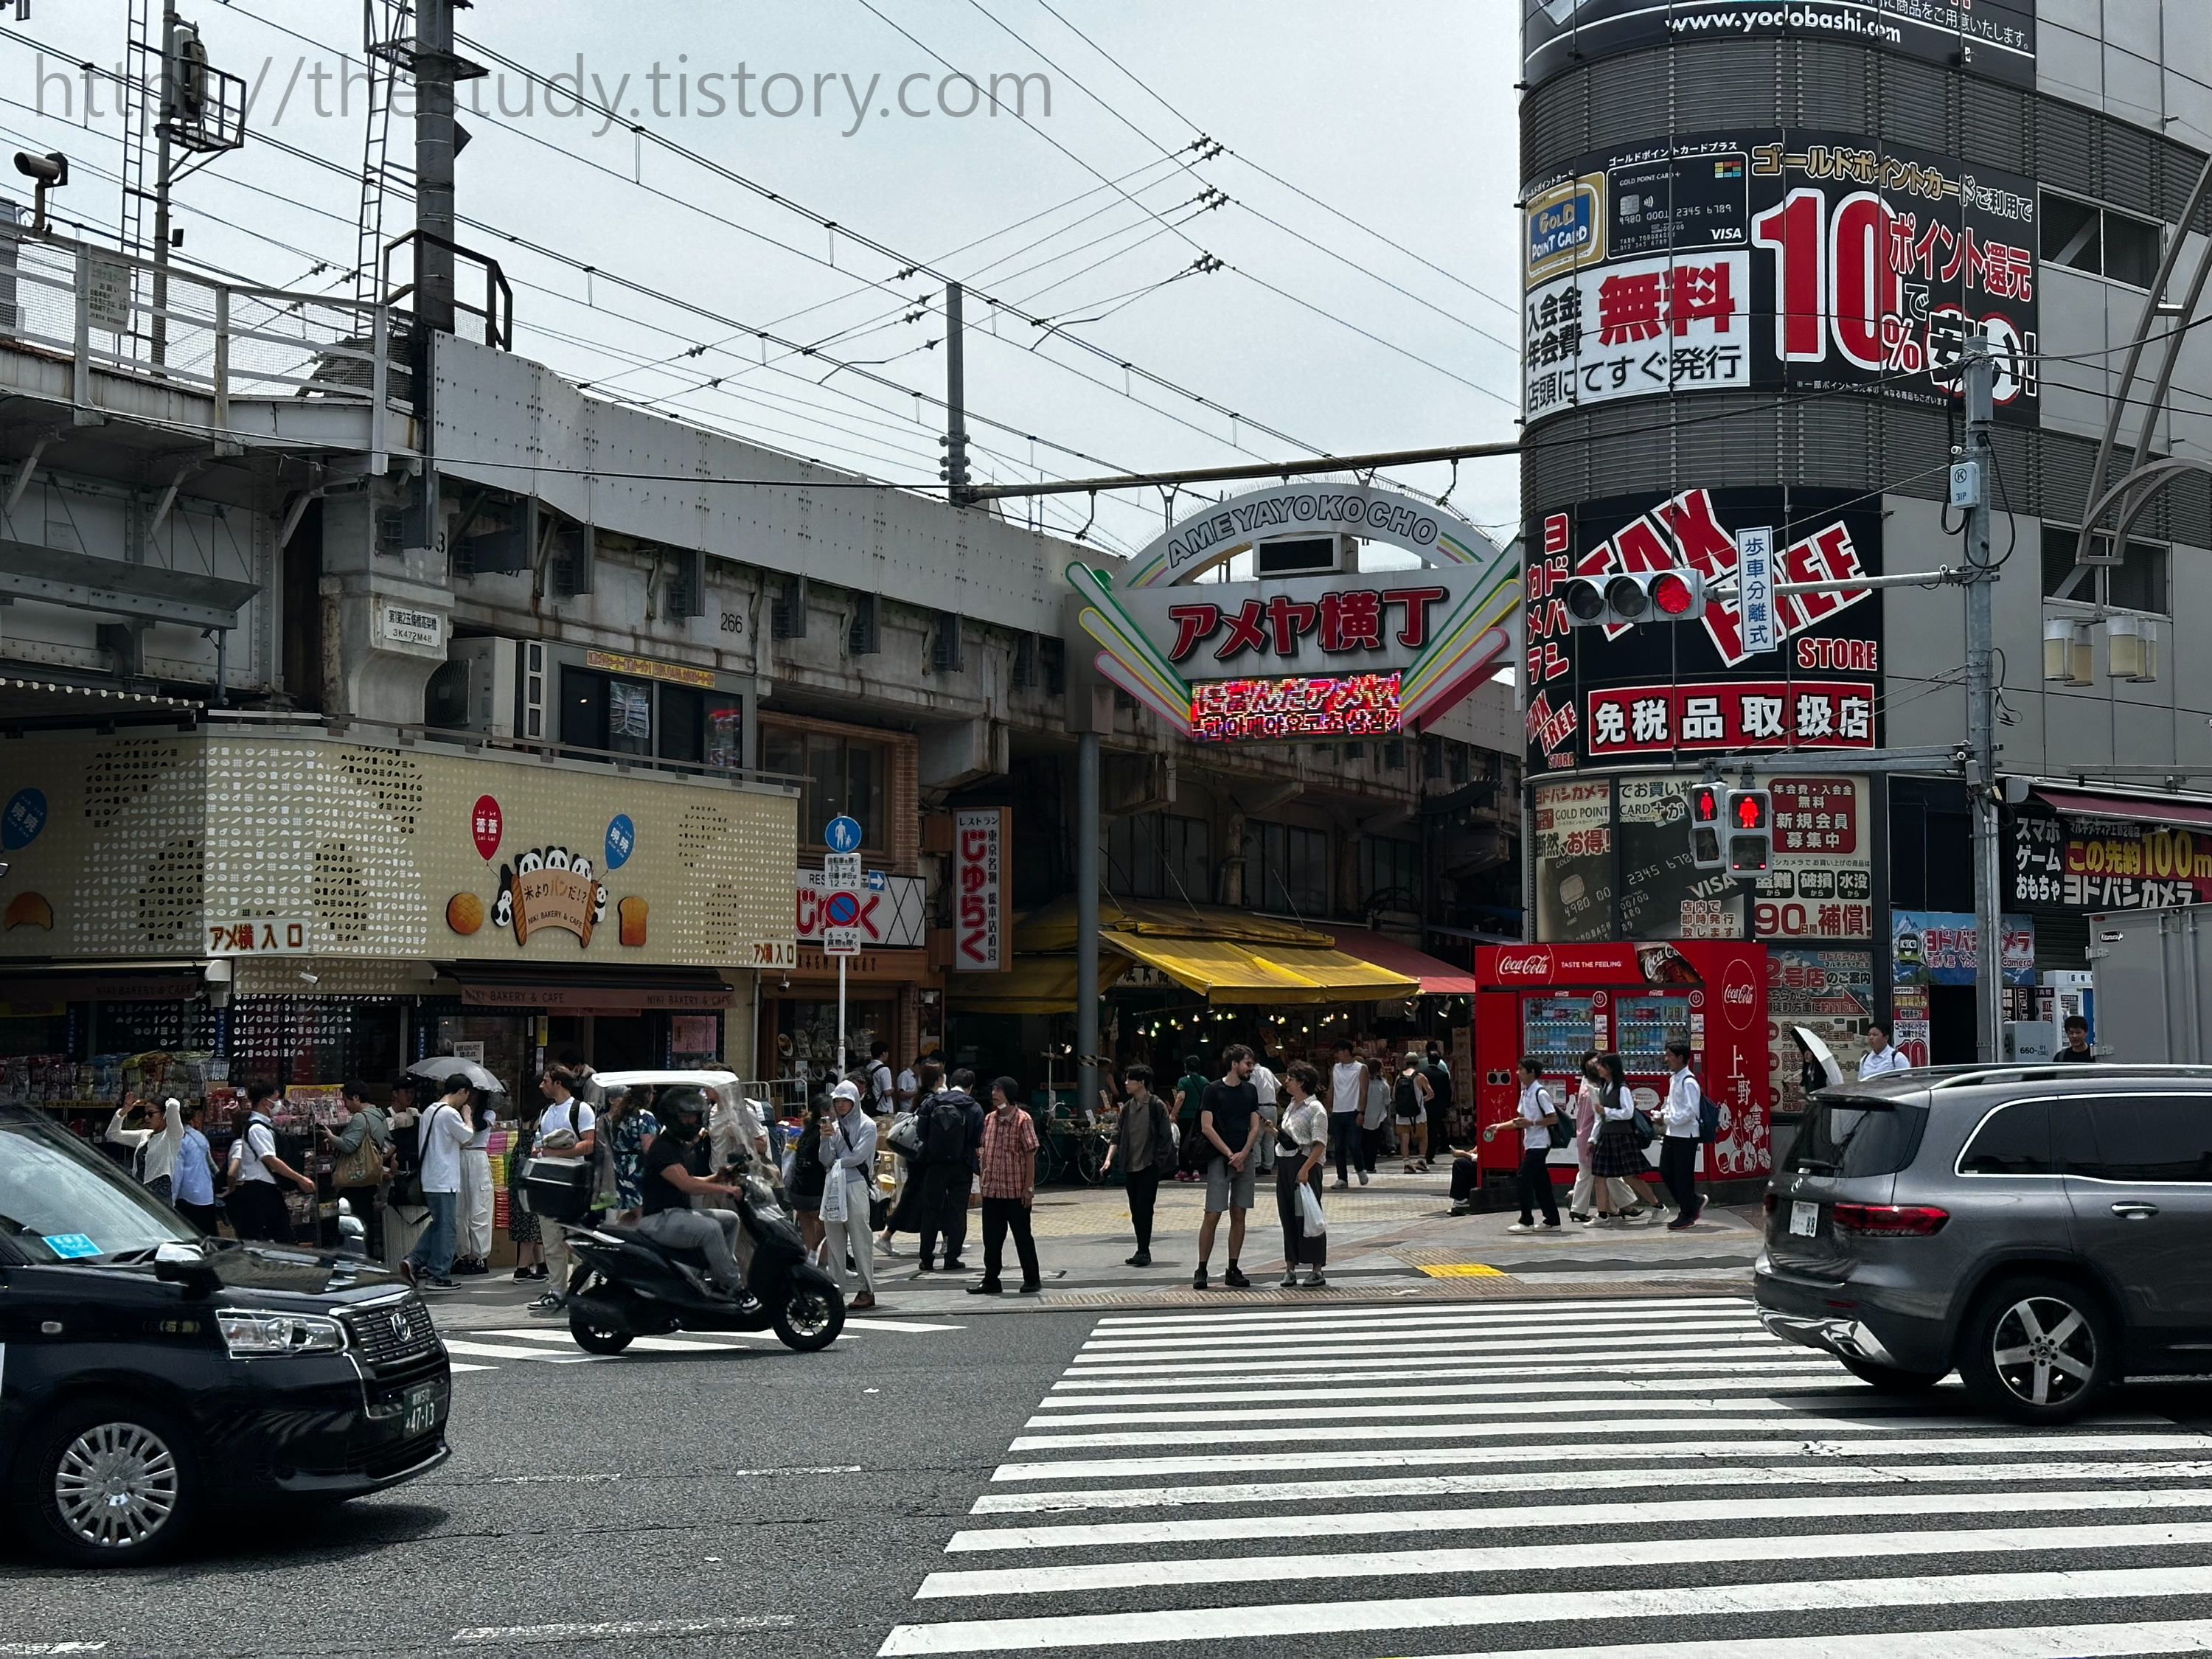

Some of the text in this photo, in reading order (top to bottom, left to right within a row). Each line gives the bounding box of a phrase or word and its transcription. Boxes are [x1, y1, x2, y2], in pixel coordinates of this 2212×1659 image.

[1665, 9, 1901, 44] www.yodobashi.com
[1636, 173, 1656, 184] POINT
[1538, 203, 1575, 235] GOLD
[1676, 206, 1701, 218] 2345
[1708, 227, 1743, 240] VISA
[1531, 234, 1556, 261] POINT
[1888, 211, 2032, 303] ポイント還元
[1528, 285, 1583, 338] 入会金
[1598, 262, 1736, 347] 無料
[1527, 322, 1582, 372] 年会費
[1527, 345, 1742, 411] 店頭にてすぐ発行
[1166, 493, 1440, 570] AMEYAYOKOCHO
[1543, 512, 1570, 681] ヨドバシ
[1744, 536, 1770, 646] 歩車分離式
[720, 611, 742, 634] 266
[1166, 585, 1450, 663] アメヤ横丁
[1526, 563, 1543, 686] カメラ
[1796, 636, 1878, 672] STORE
[1526, 689, 1554, 745] TAX
[1540, 700, 1577, 757] FREE
[1593, 694, 1870, 746] 免税品取扱店
[1548, 752, 1575, 769] STORE
[1773, 785, 1852, 796] 年会費・入会金
[1798, 796, 1825, 809] 無料
[959, 816, 998, 827] レストラン
[1556, 809, 1577, 820] GOLD
[1579, 806, 1609, 818] POINT
[1619, 804, 1650, 815] CARD
[1775, 813, 1848, 830] 新規会員
[1787, 832, 1840, 849] 募集中
[2016, 818, 2061, 843] スマホ
[2016, 844, 2062, 872] ゲーム
[1627, 865, 1660, 885] 2345
[1686, 873, 1738, 899] VISA
[1801, 872, 1833, 889] 破損
[1839, 872, 1868, 889] 水没
[2016, 874, 2061, 901] おもちゃ
[2064, 874, 2194, 908] ヨドバシカメラ
[1681, 900, 1721, 913] 店内で
[1681, 914, 1734, 925] 即時発行
[540, 911, 561, 919] BAKERY
[569, 916, 583, 929] CAFE
[2001, 956, 2034, 968] Camera
[490, 991, 525, 1002] BAKERY
[542, 992, 564, 1004] CAFE
[669, 995, 697, 1005] BAKERY
[1727, 1045, 1751, 1106] 上野
